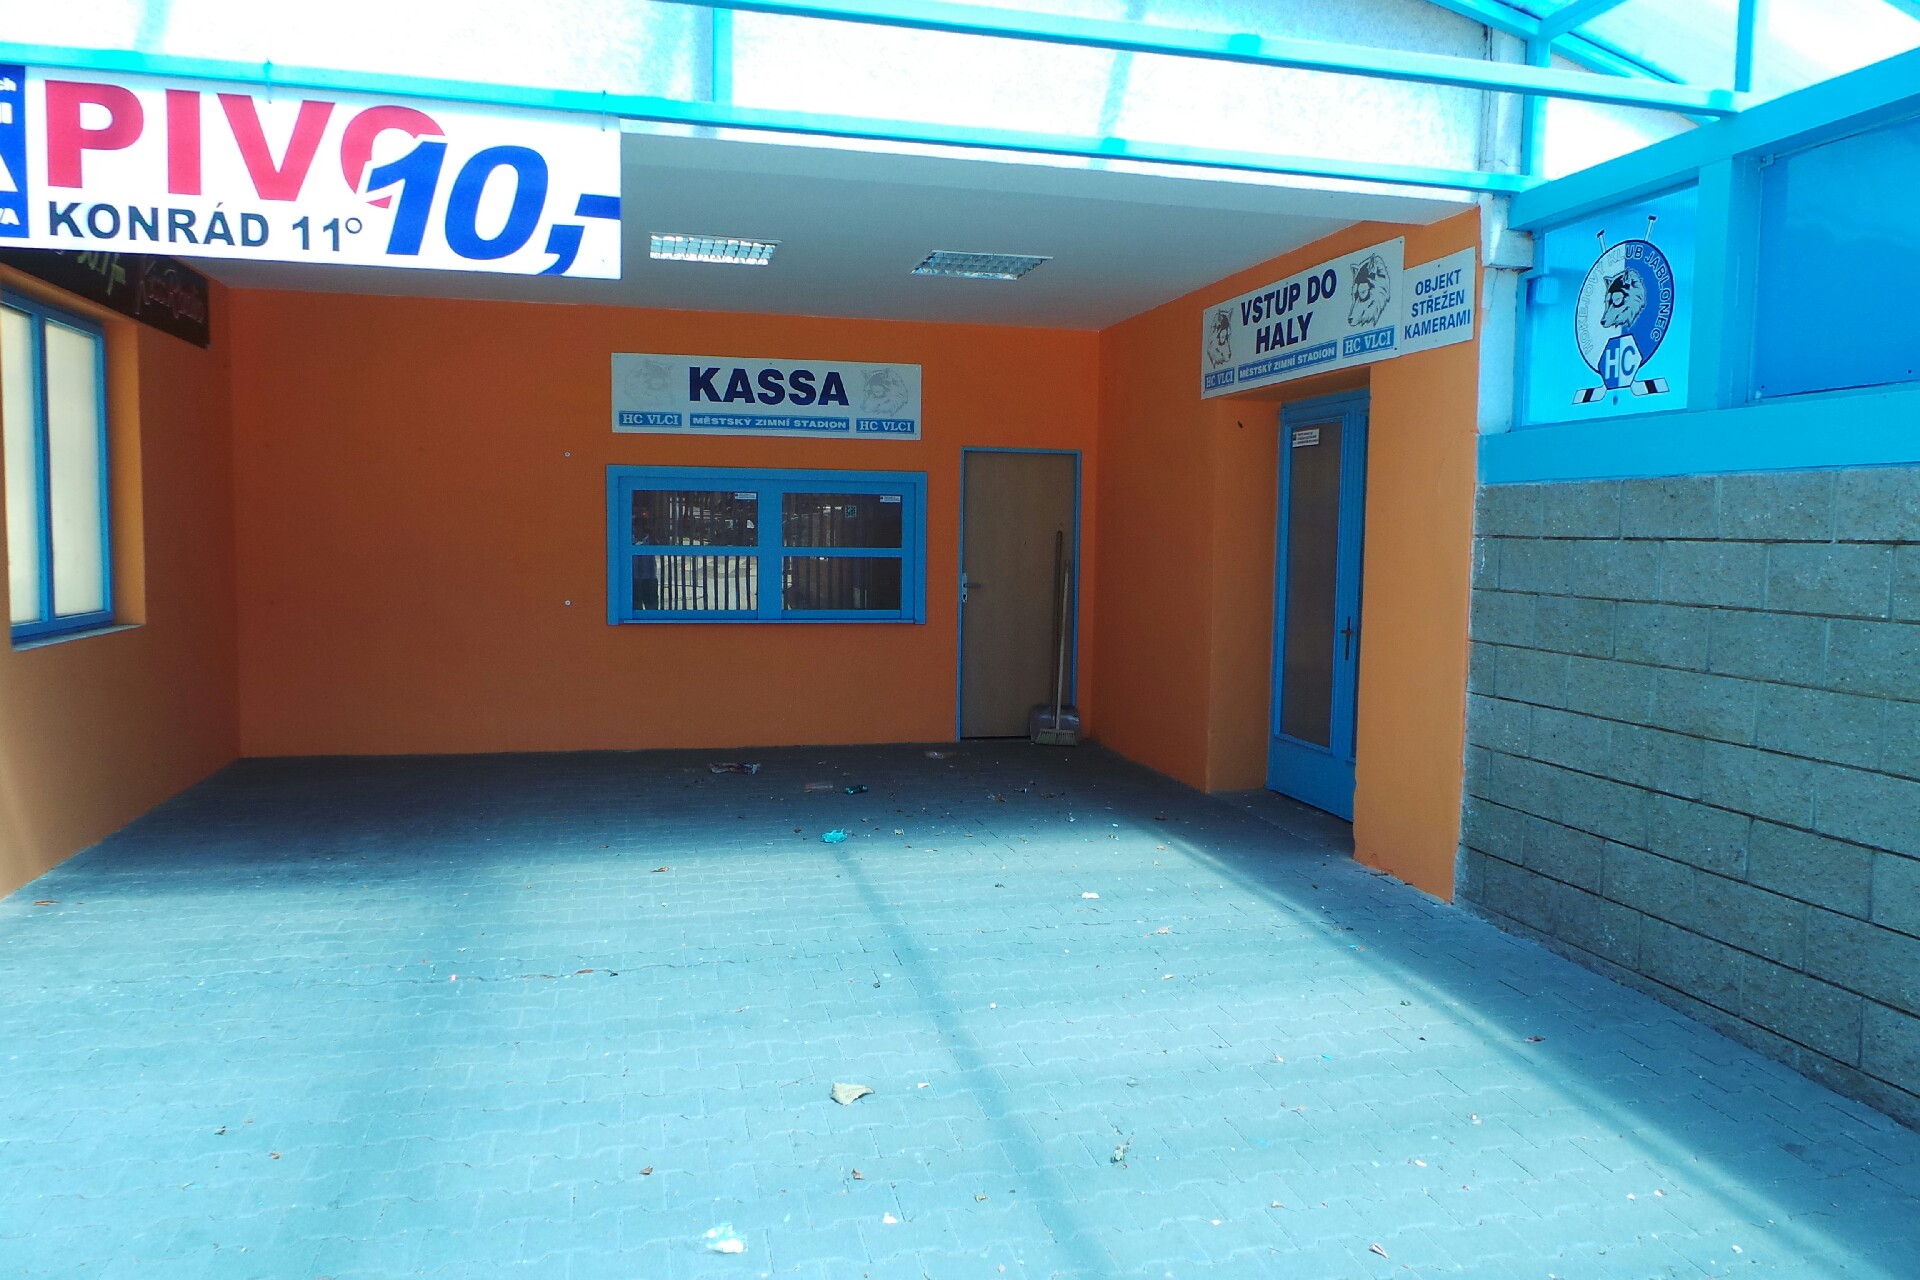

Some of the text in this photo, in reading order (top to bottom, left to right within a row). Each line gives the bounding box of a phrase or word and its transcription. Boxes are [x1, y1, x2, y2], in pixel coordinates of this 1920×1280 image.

[48, 200, 270, 248] KONRÁD
[1240, 268, 1337, 326] VSTUP DO
[1415, 268, 1462, 296] OBJEKT
[1608, 244, 1644, 267] KLUB
[1645, 252, 1672, 342] JABLONEC
[1411, 289, 1465, 318] STŘEŽEN
[1255, 311, 1313, 355] HALY
[1404, 309, 1471, 340] KAMERAMI
[1344, 330, 1392, 354] HC VLCI
[1239, 346, 1336, 378] MĚSTSKÝ ZIMNÍ STADION
[1605, 345, 1636, 379] HC
[689, 366, 850, 406] KASSA
[1217, 371, 1234, 386] VLCI
[623, 413, 679, 425] HC VLCI
[692, 415, 847, 429] MĚSTSKÝ ZIMNÍ STADION
[860, 420, 912, 432] HC VLCI
